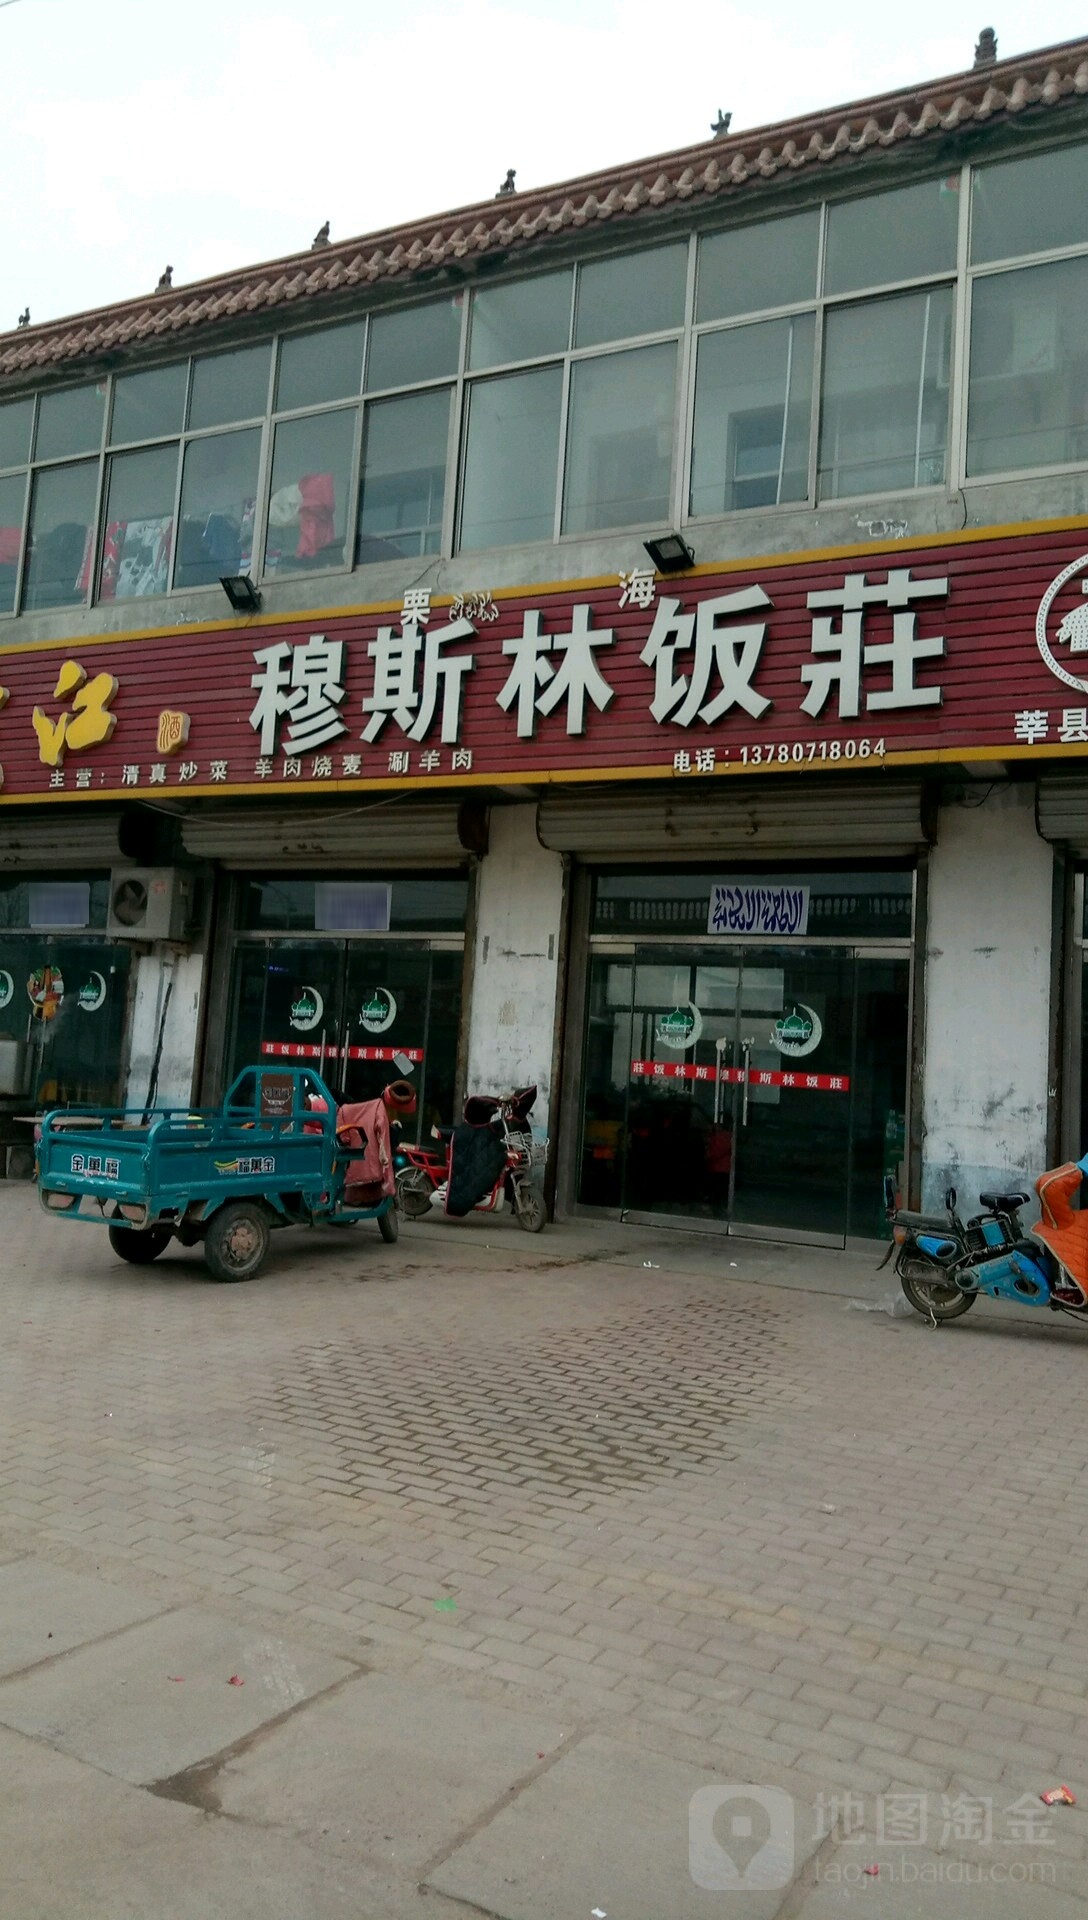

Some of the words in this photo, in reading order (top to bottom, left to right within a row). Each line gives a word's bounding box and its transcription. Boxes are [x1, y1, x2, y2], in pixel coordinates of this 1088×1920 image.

[618, 567, 656, 608] 海
[401, 588, 432, 625] 栗
[1013, 707, 1088, 745] 莘县
[254, 754, 362, 779] 羊肉烧麦
[387, 748, 473, 774] 涮羊肉
